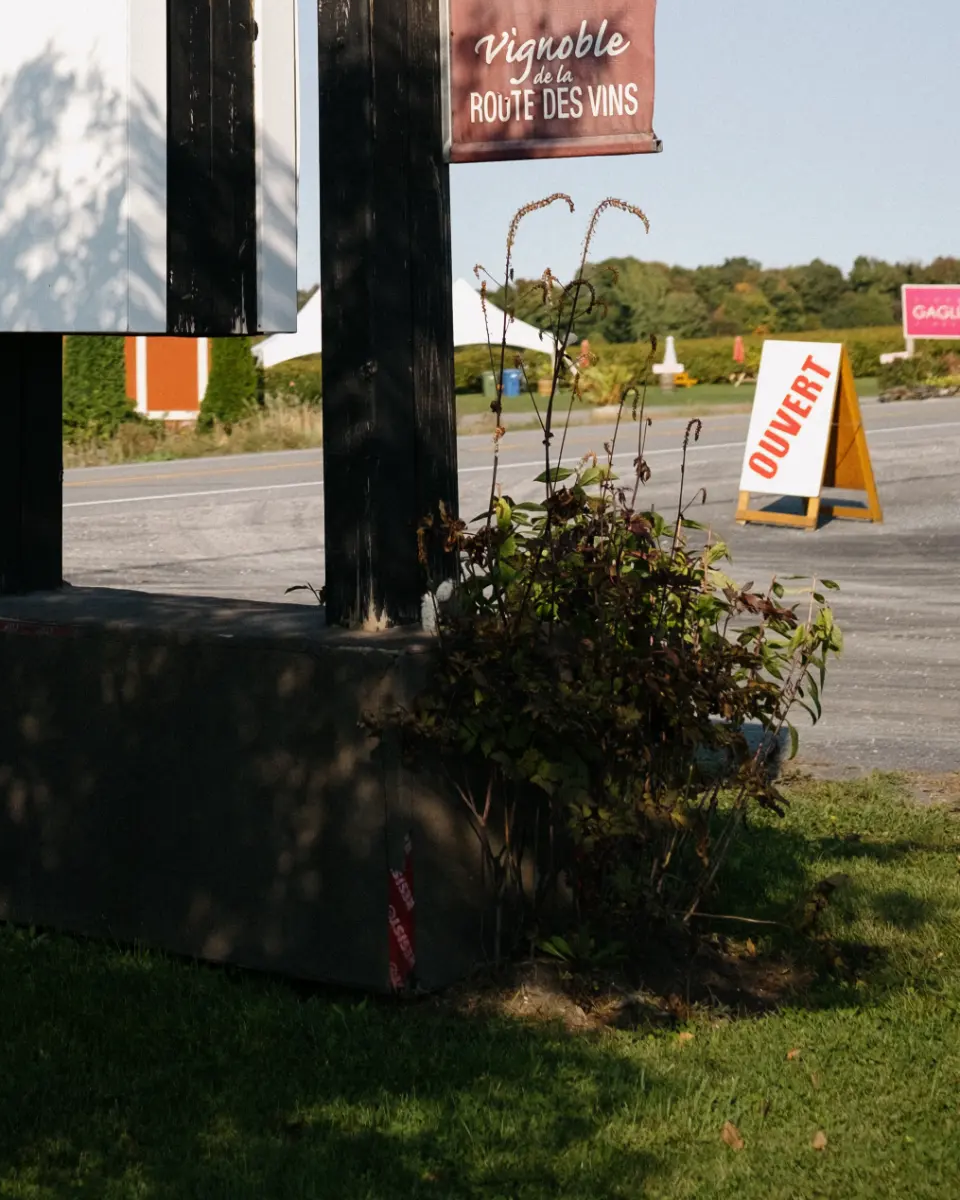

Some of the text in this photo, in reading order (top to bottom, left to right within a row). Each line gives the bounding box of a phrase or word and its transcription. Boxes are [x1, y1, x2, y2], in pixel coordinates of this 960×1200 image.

[475, 20, 630, 85] Vignoble
[534, 64, 573, 84] de la
[470, 83, 638, 123] ROUTE DES VINS
[749, 355, 831, 479] OUVERT
